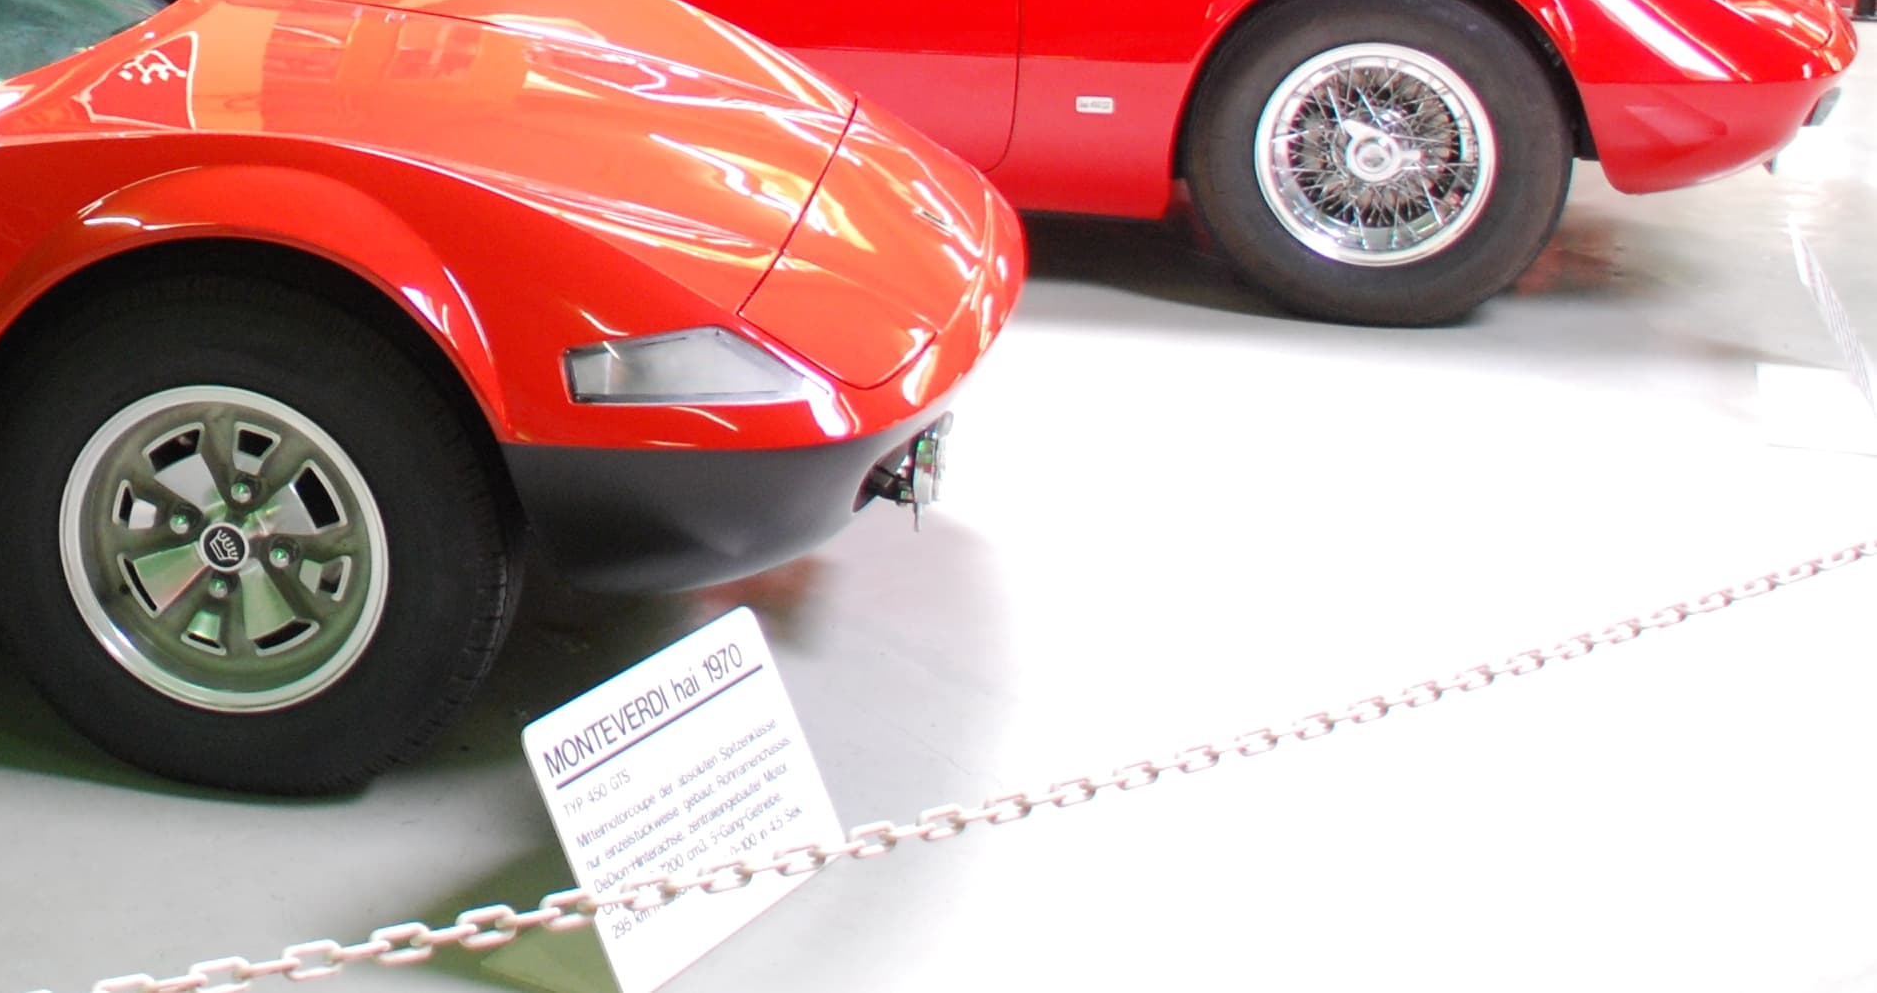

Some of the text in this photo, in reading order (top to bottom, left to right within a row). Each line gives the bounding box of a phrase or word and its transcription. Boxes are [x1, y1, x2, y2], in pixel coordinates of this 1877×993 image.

[542, 642, 743, 778] MONTEVERDI hai 1970
[562, 767, 631, 818] TYP 450 GTS
[656, 779, 674, 799] der
[584, 852, 601, 871] nur
[610, 915, 633, 939] 295
